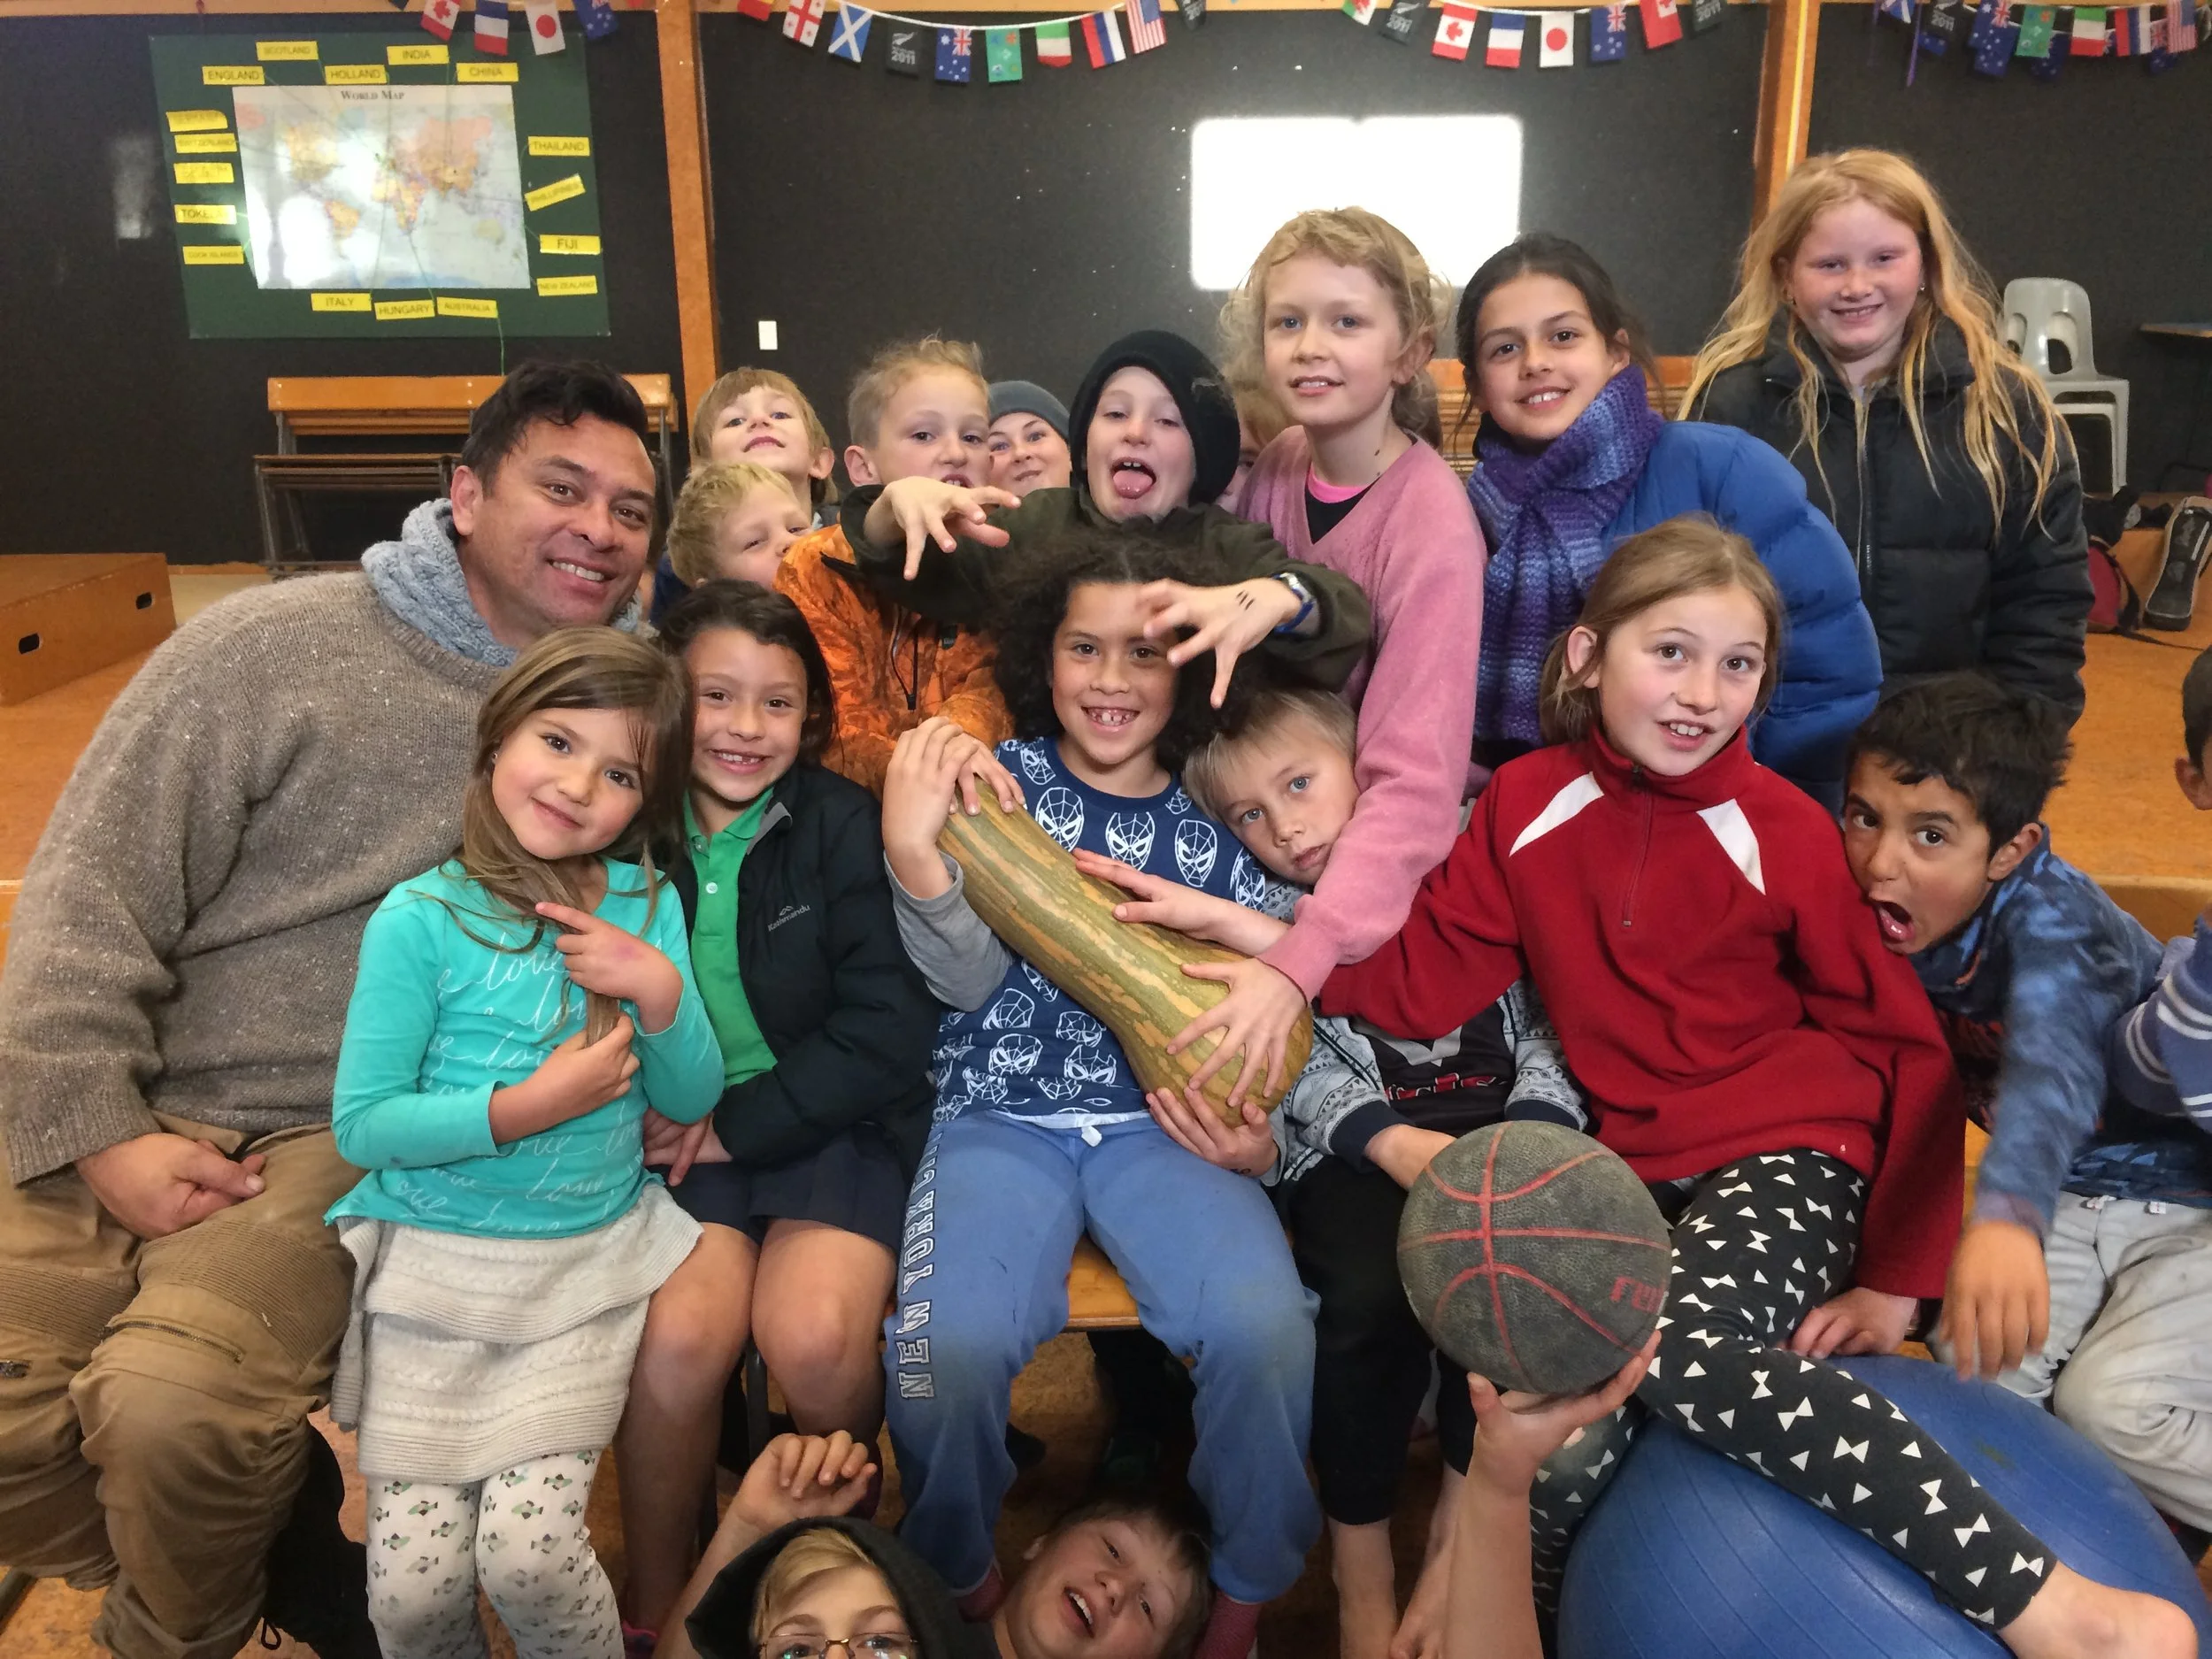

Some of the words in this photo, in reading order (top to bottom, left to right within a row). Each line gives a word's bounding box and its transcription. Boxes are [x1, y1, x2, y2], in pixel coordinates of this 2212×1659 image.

[403, 50, 432, 60] INDIA
[891, 50, 916, 65] 2011
[207, 70, 259, 81] ENGLAND
[330, 69, 380, 79] HOLLAND
[469, 67, 503, 77] CHINA
[533, 141, 585, 151] THAILAND
[557, 239, 578, 250] FIJI
[326, 297, 354, 307] ITALY
[444, 303, 490, 312] AUSTRALIA
[379, 303, 429, 315] HUNGARY
[767, 904, 811, 932] Kathmandu
[900, 1189, 936, 1295] YORK
[894, 1299, 935, 1401] NEW
